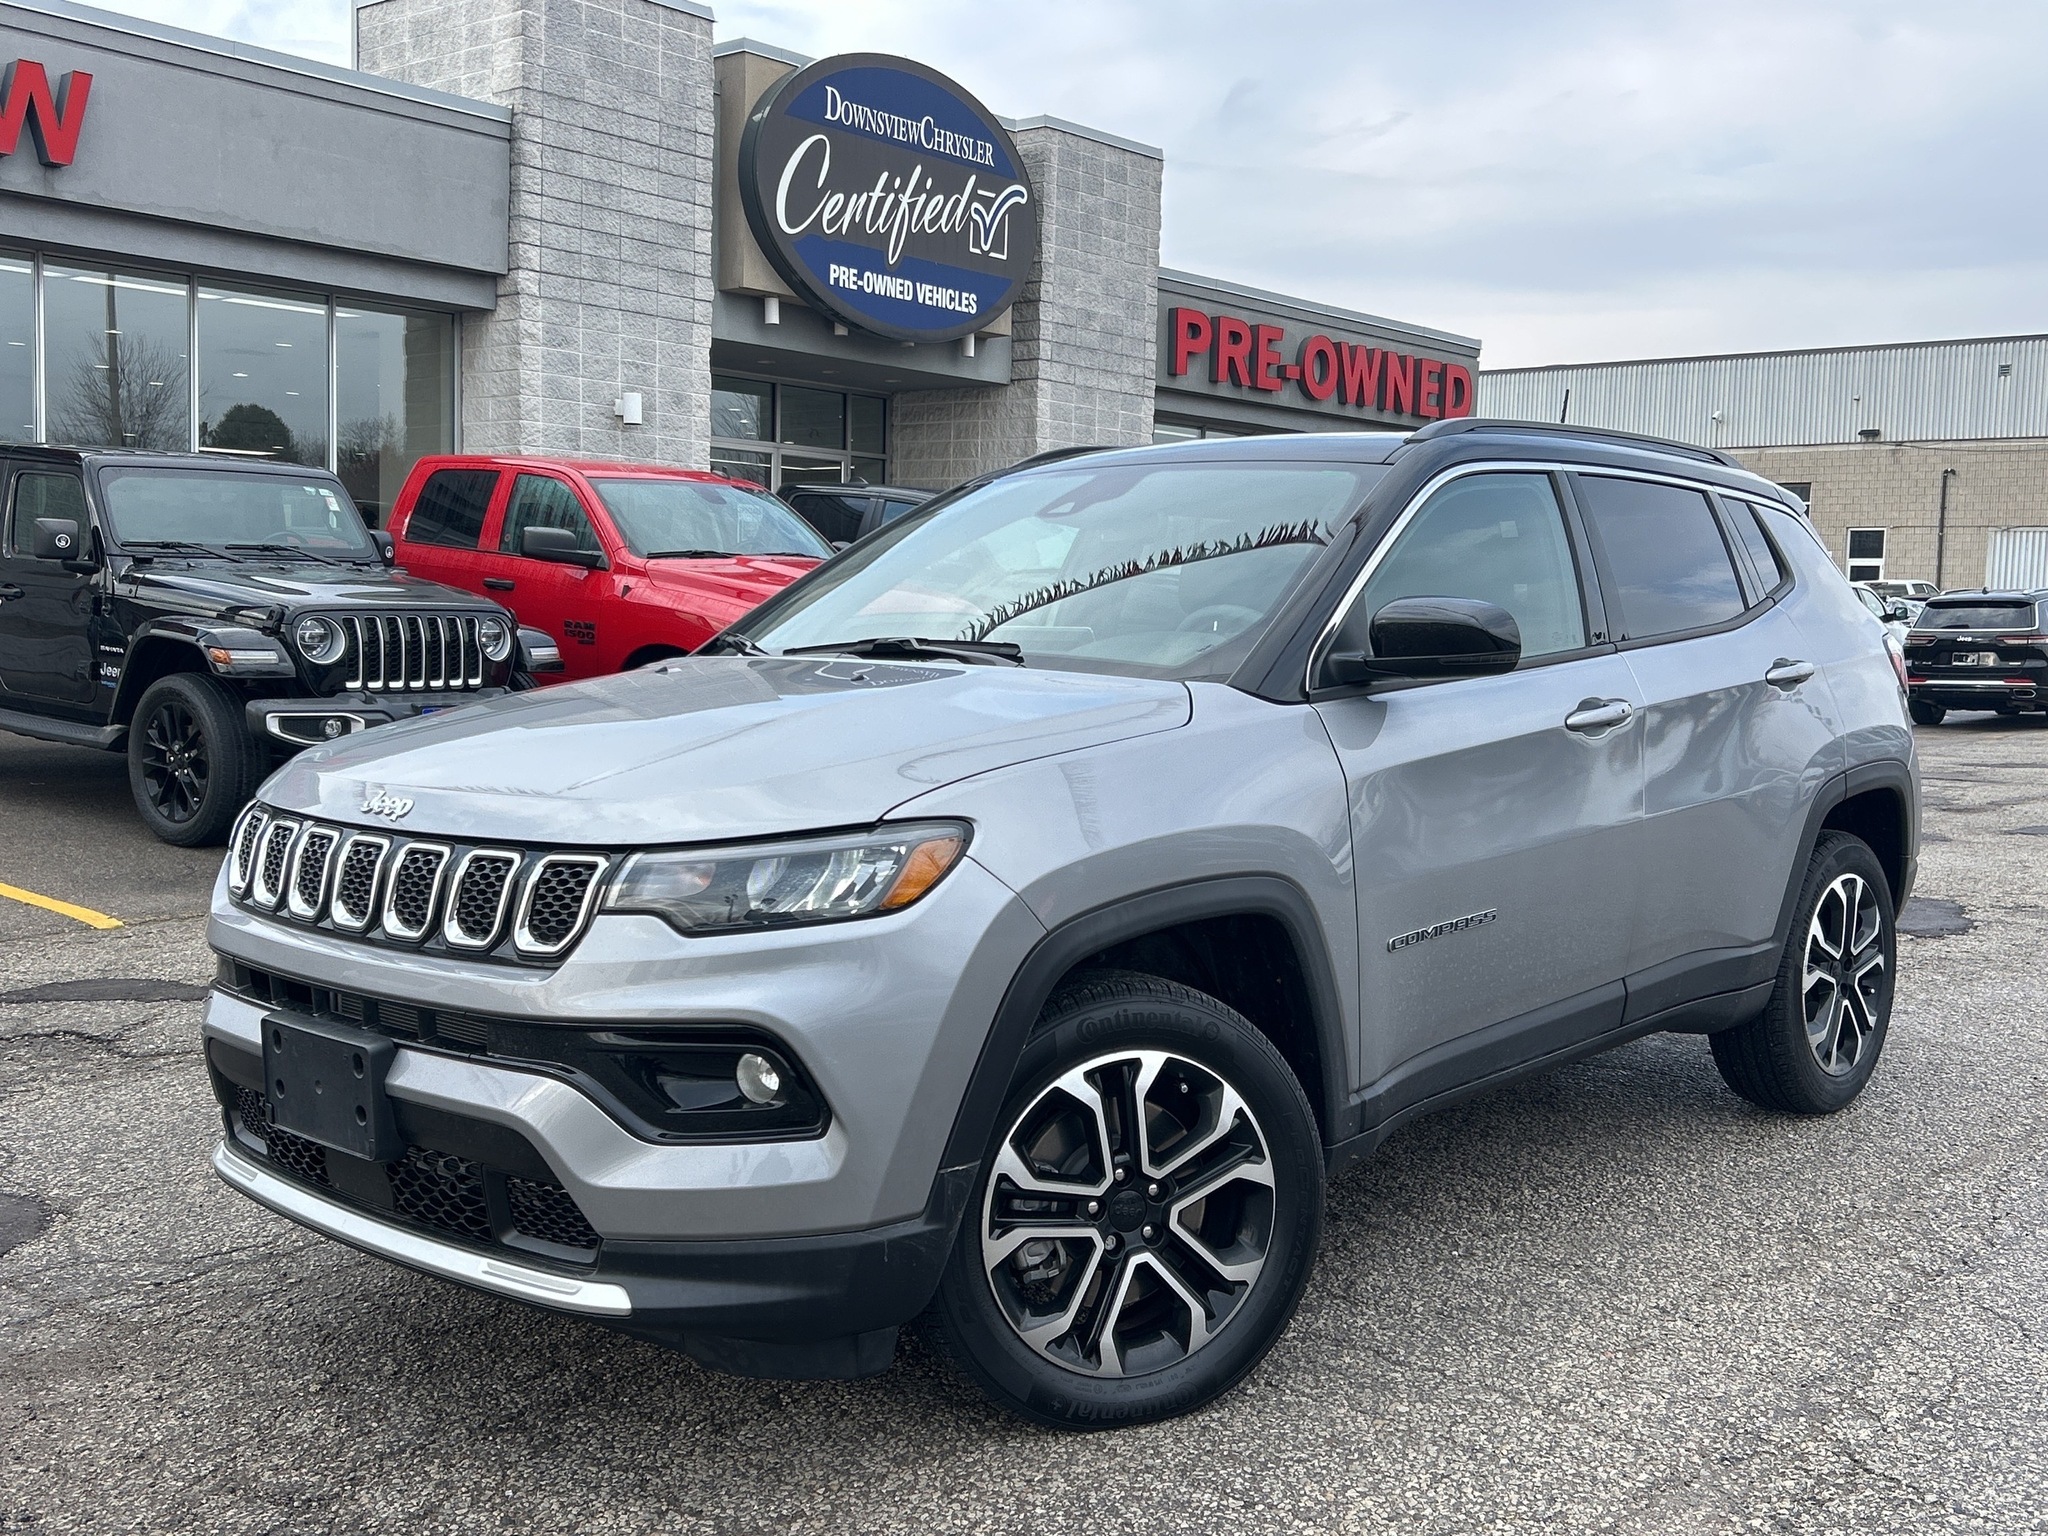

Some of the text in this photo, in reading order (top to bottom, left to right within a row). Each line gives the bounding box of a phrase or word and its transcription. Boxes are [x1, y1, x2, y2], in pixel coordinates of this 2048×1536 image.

[0, 58, 93, 168] W
[776, 134, 977, 265] Certified
[829, 263, 978, 315] PRE-OWNED VEHICLES
[1168, 307, 1473, 419] PRE-OWNED
[564, 620, 595, 630] RAM
[564, 629, 595, 639] 1500
[360, 789, 415, 822] Jeep
[1387, 908, 1498, 953] COMPASS
[1076, 1008, 1201, 1044] Continental
